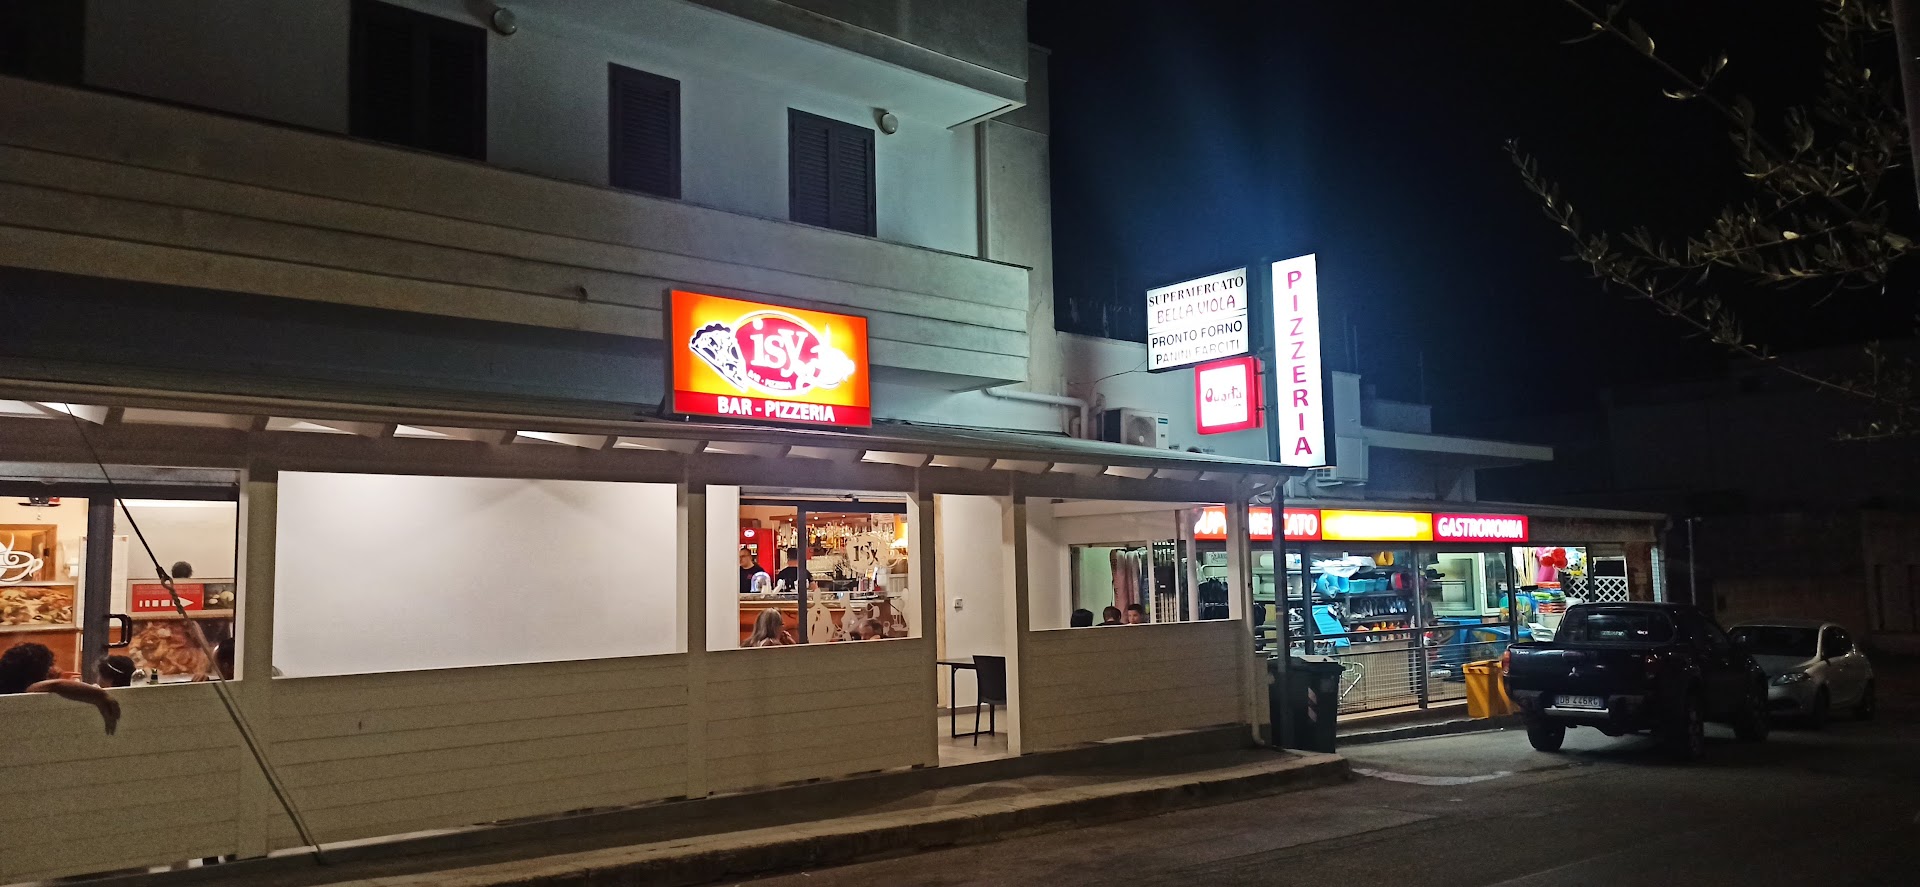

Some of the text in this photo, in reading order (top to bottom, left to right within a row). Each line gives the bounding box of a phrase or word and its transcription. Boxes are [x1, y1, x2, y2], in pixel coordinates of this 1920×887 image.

[1149, 276, 1244, 307] SUPERMERCATO
[1157, 294, 1236, 324] BELLA VIOLA
[1152, 320, 1243, 348] PRONTO FORNO
[1156, 339, 1239, 365] PANINI FARCITI
[1287, 270, 1313, 455] PIZZERIA
[717, 396, 753, 416] BAR
[764, 400, 836, 422] PIZZERIA
[1438, 517, 1524, 538] GASTRONOMIA
